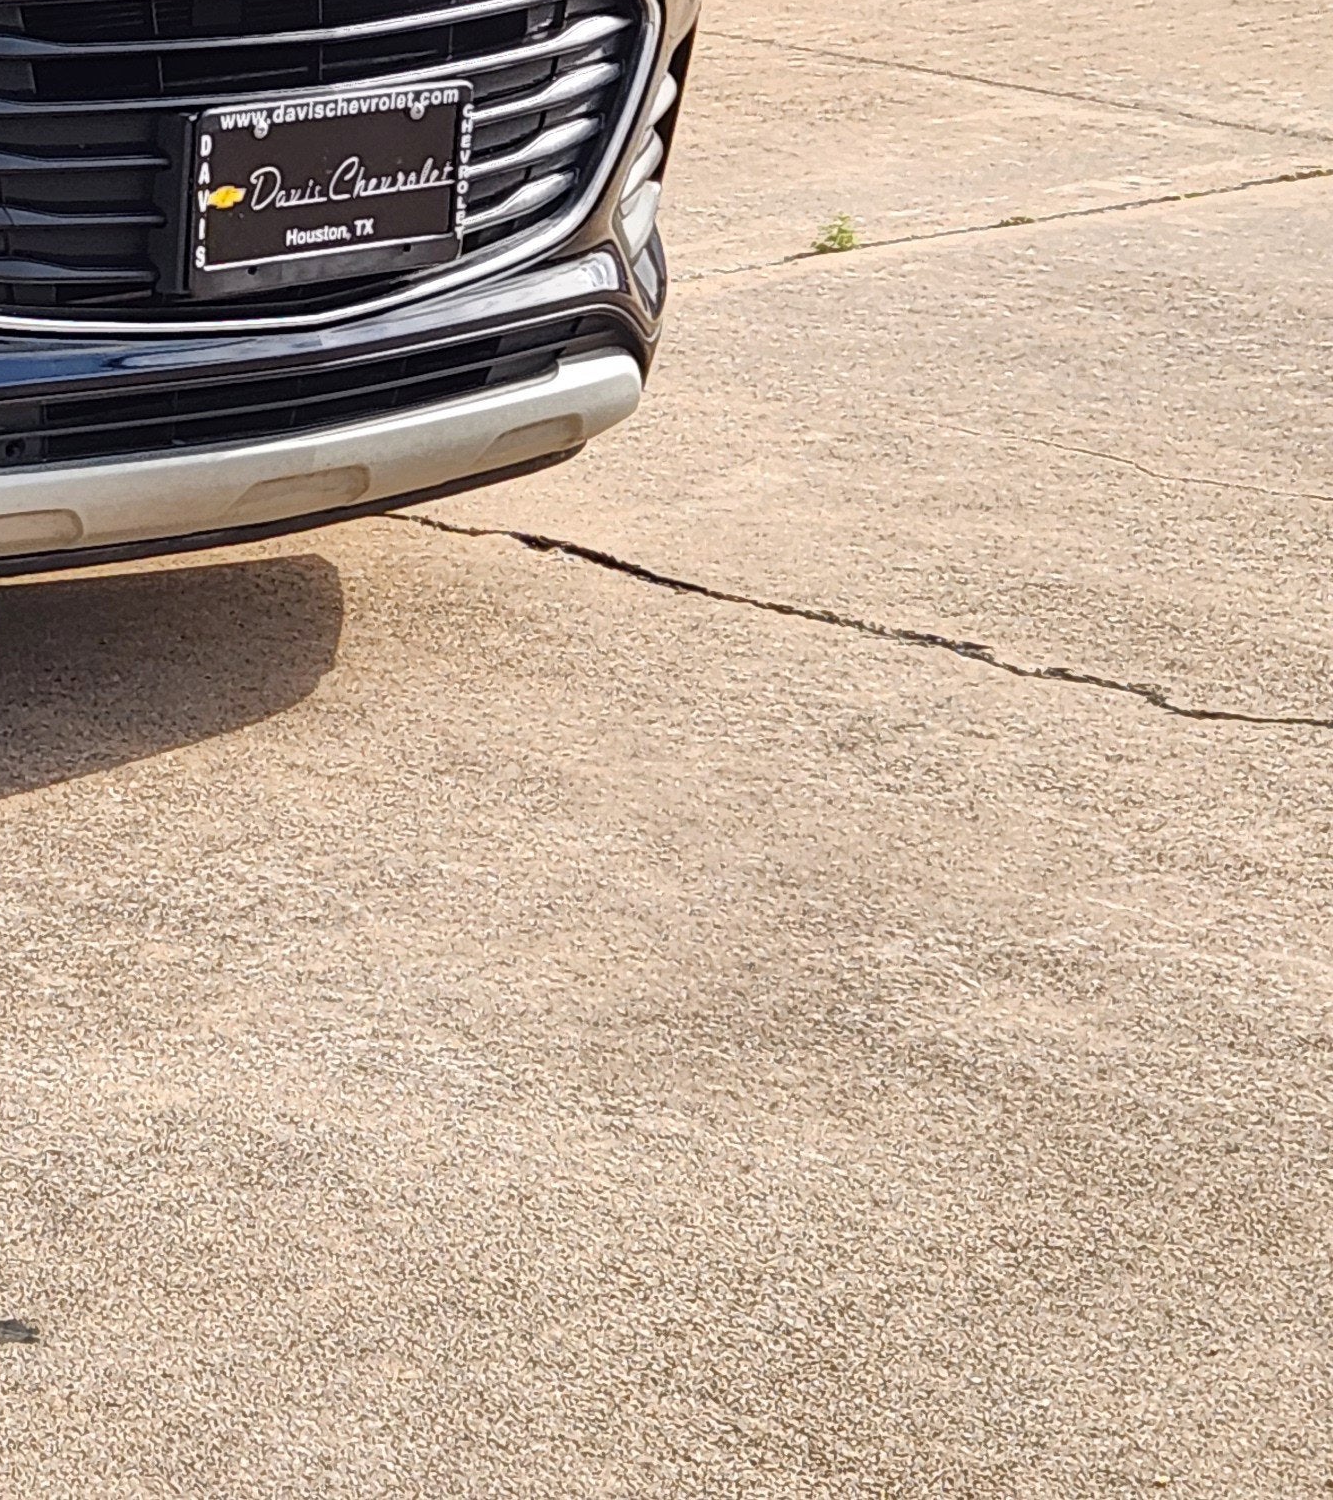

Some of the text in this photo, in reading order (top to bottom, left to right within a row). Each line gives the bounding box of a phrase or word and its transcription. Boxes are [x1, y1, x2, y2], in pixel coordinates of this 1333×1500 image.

[220, 88, 459, 130] www.davischevrolet.com
[250, 156, 455, 211] Davis Chevrolet
[455, 103, 474, 240] CHEVROLET
[196, 134, 212, 268] DAVIS
[286, 218, 375, 246] Houston, TX
